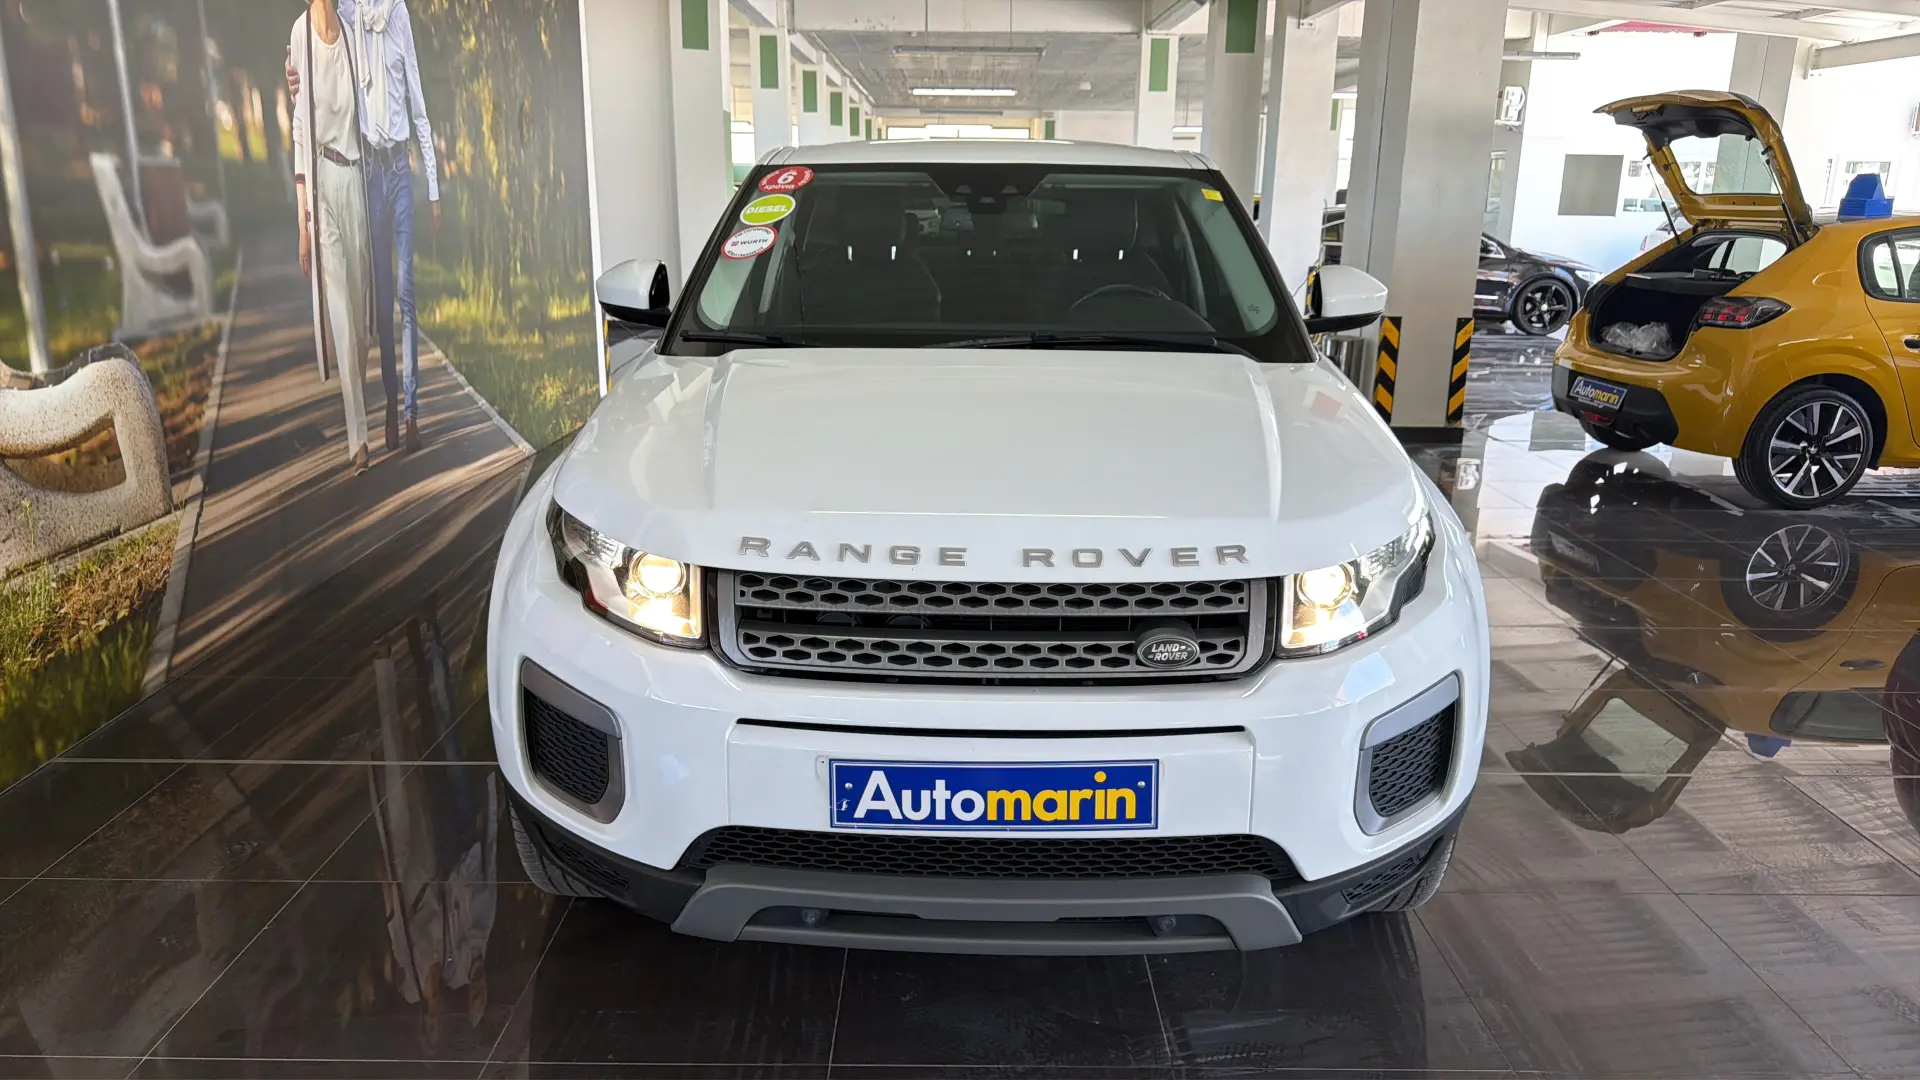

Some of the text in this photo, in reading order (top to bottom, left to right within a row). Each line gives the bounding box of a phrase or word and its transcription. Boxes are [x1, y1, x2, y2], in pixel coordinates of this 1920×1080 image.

[777, 170, 798, 185] 6
[745, 204, 789, 215] DIESEL
[1573, 380, 1620, 405] Automarin
[738, 536, 1250, 568] RANGE ROVER
[1151, 643, 1180, 653] LAND
[1153, 651, 1188, 661] ROVER
[853, 770, 1137, 822] Automarin
